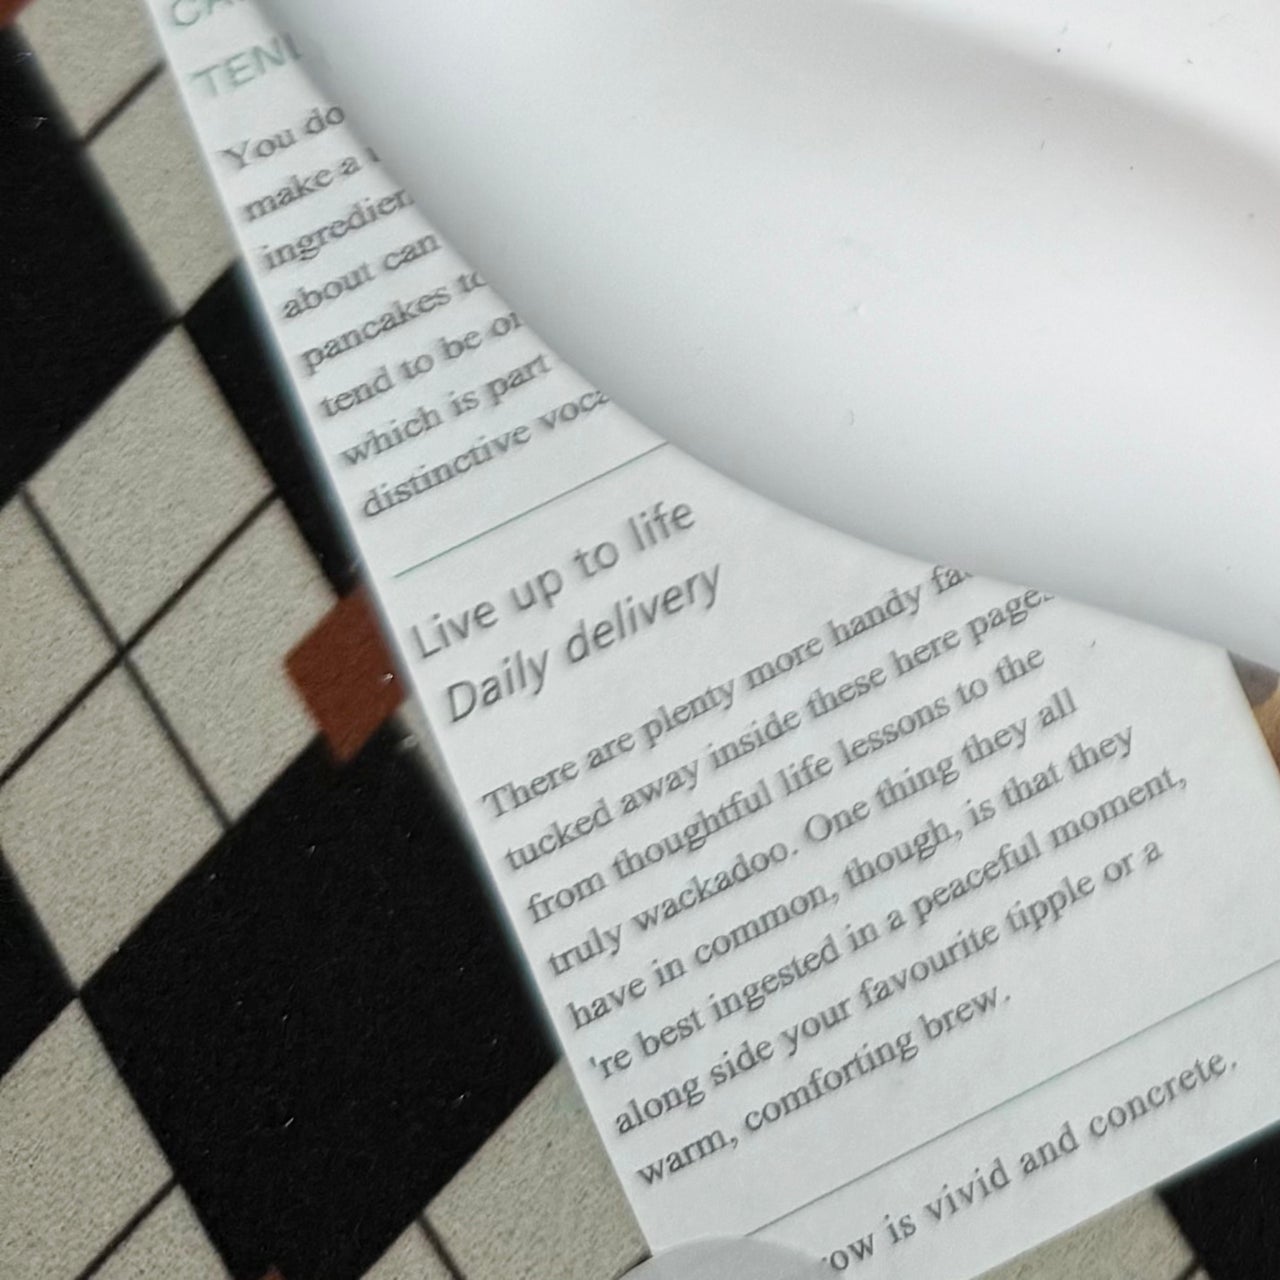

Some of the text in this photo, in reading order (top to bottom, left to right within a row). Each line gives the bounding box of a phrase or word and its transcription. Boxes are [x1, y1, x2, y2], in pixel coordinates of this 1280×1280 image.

[221, 102, 346, 175] You do
[242, 152, 360, 223] make a
[281, 229, 441, 320] about can
[300, 283, 451, 377] pancakes
[318, 362, 394, 419] tend
[398, 350, 435, 381] to
[438, 326, 483, 360] be
[339, 347, 552, 469] which is part
[356, 422, 532, 519] distinctive
[408, 501, 698, 659] Live up to life
[440, 566, 731, 722] Daily delivery
[481, 759, 580, 820] There
[584, 730, 636, 769] are
[640, 678, 741, 748] plenty
[743, 635, 825, 689] more
[825, 584, 928, 646] handy
[504, 796, 613, 871] tucked
[617, 758, 707, 814] away
[706, 708, 802, 768] inside
[804, 665, 888, 719] these
[888, 627, 962, 676] here
[524, 647, 1047, 923] from thoughtful life lessons to the
[546, 687, 1078, 975] truly wackadoo. One thing they all
[566, 726, 1140, 1029] have in common, though, is that they
[635, 1006, 706, 1057] best
[708, 934, 841, 1020] ingested
[844, 921, 880, 951] in
[885, 908, 906, 931] a
[911, 831, 1042, 925] peaceful
[1048, 766, 1188, 848] moment,
[614, 839, 1164, 1134] along side your favourite tipple or a
[637, 986, 1011, 1186] warm, comforting brew.
[882, 1214, 917, 1244] is
[924, 1158, 1010, 1223] vivid
[1018, 1122, 1080, 1175] and
[1086, 1054, 1238, 1140] concrete.
